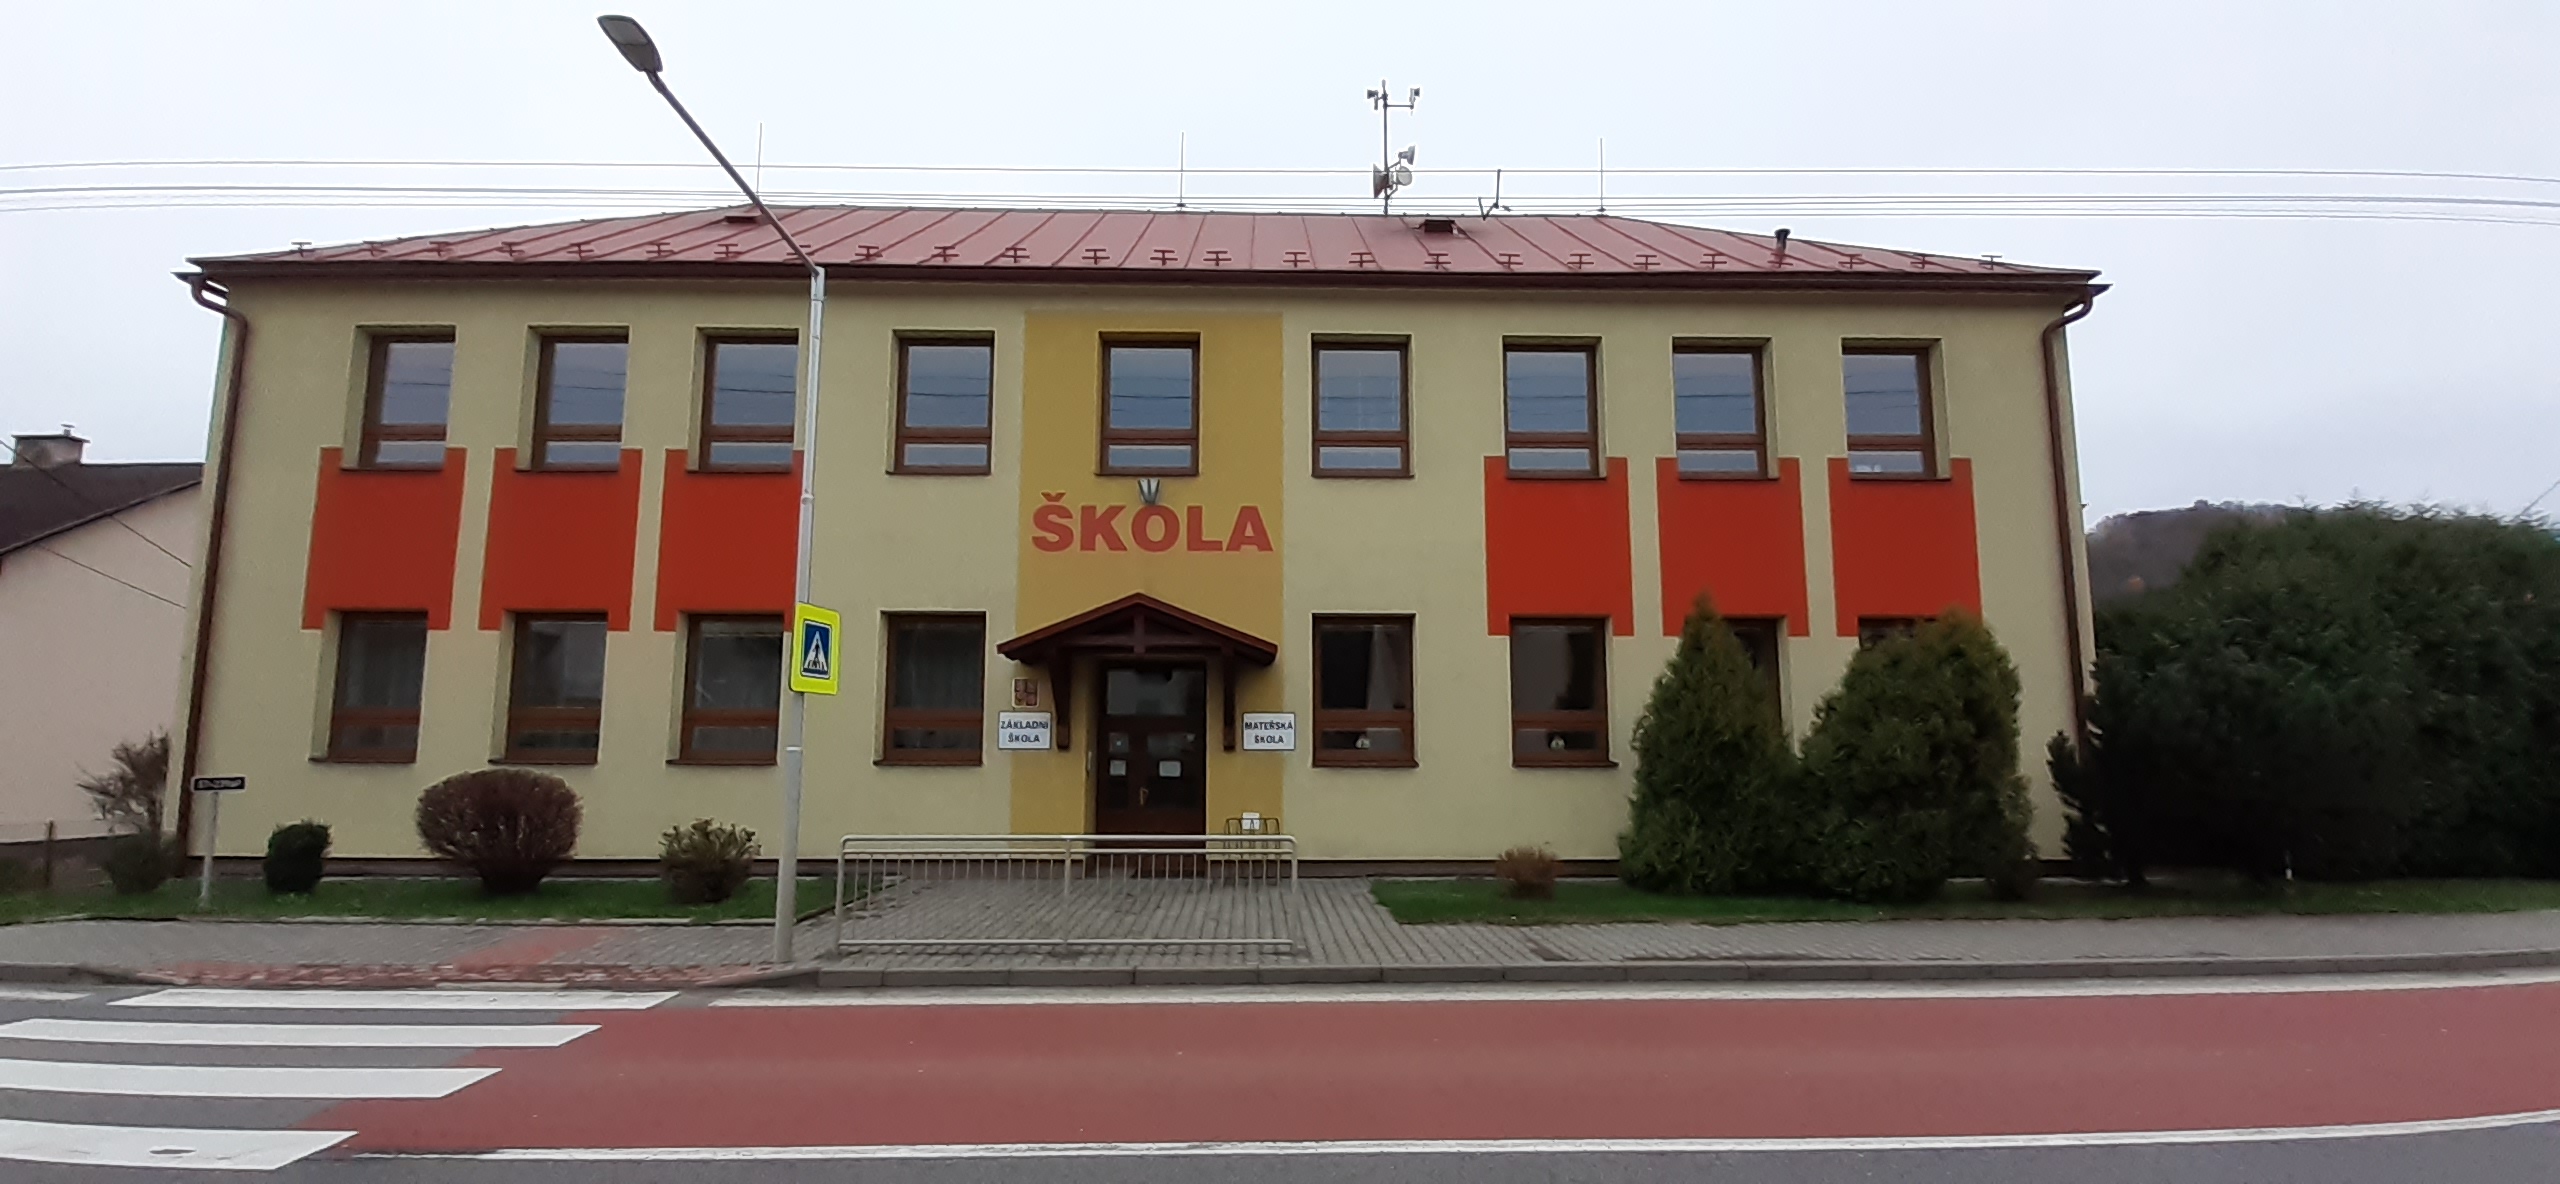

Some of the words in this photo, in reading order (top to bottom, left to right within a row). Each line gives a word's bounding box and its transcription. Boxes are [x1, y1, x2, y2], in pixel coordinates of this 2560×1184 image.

[1032, 492, 1274, 552] ŠKOLA
[1245, 720, 1294, 730] MATEŘSKÁ
[1008, 732, 1040, 743] ŠKOLA
